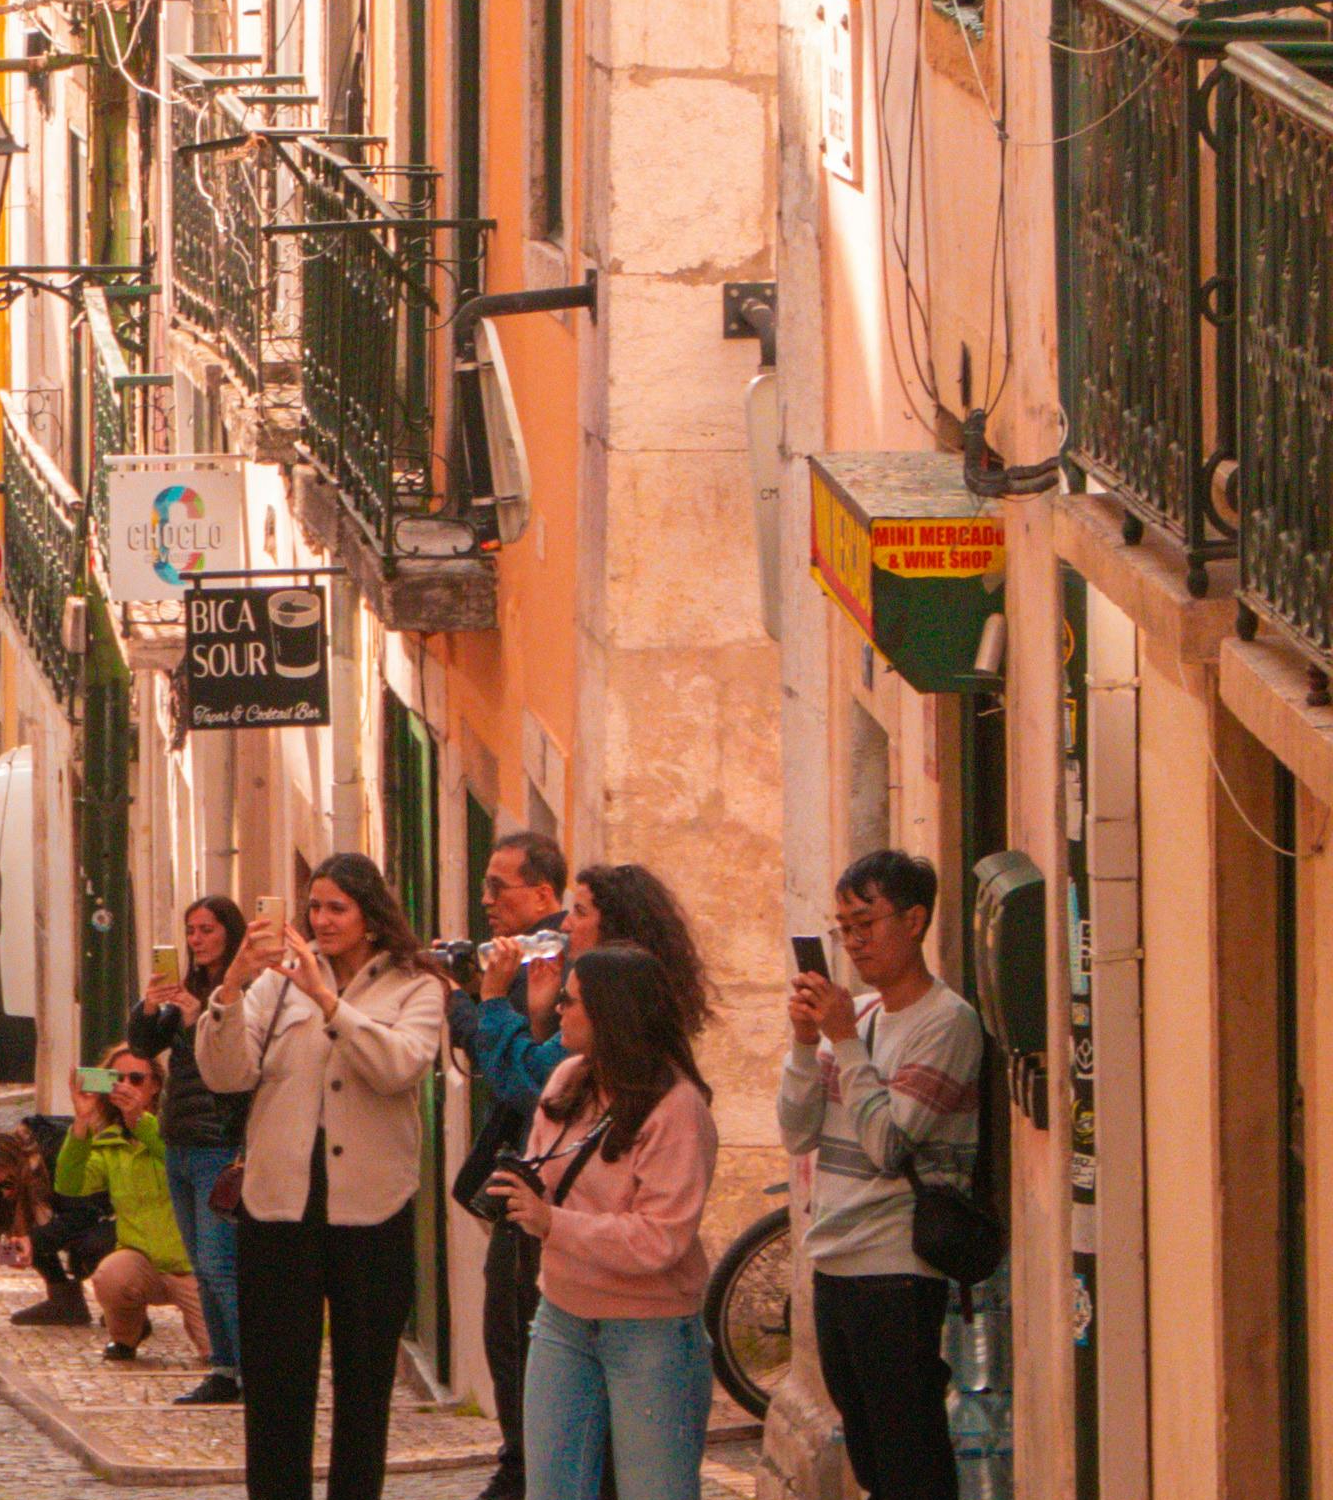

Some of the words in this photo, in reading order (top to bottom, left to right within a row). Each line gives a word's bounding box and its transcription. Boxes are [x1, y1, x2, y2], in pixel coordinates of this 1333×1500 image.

[127, 522, 222, 552] CHOCLO
[874, 526, 915, 547] MINI
[888, 553, 900, 569] &
[903, 551, 946, 569] WINE
[949, 550, 993, 569] SHOP
[191, 599, 256, 634] BICA
[192, 642, 269, 678] SOUR
[193, 705, 229, 726] Tapas
[294, 702, 322, 720] Bar
